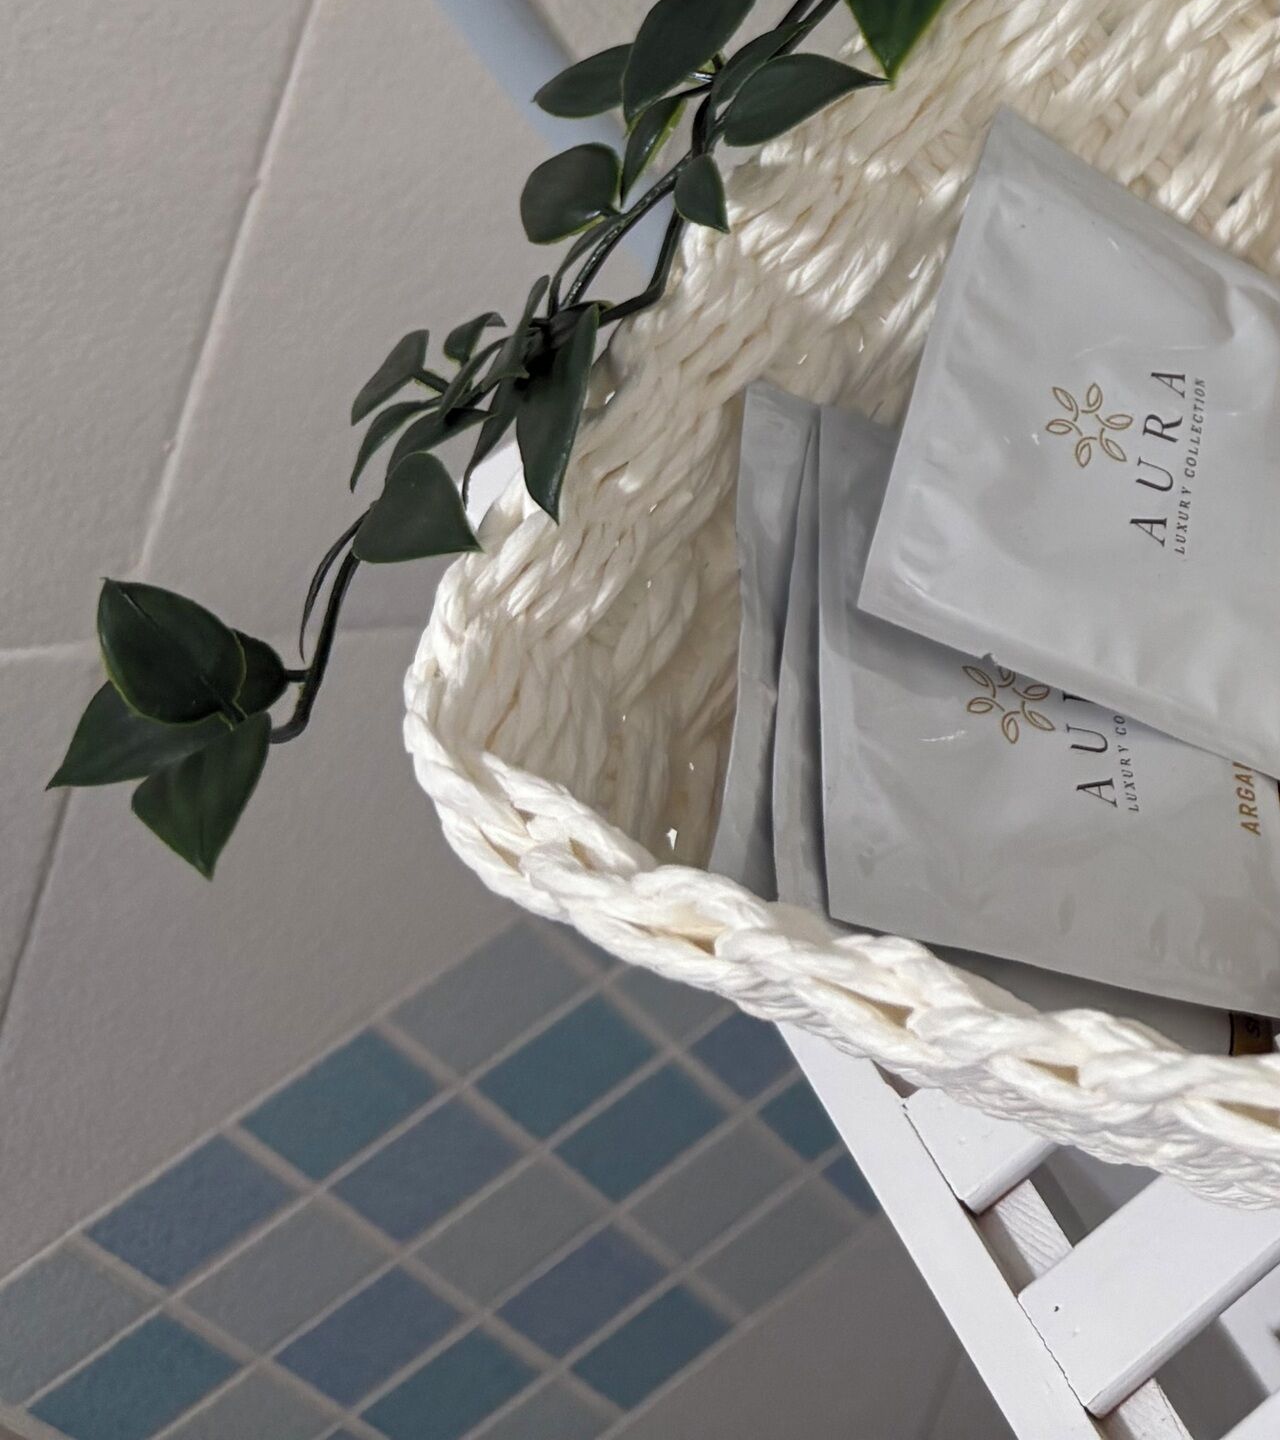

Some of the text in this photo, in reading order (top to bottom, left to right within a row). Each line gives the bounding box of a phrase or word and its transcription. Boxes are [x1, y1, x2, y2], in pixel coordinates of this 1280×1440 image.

[1129, 371, 1187, 548] AURA
[1174, 377, 1206, 555] LUXURY COLLECTION
[1062, 691, 1118, 809] AU
[1117, 744, 1140, 813] LUXURY
